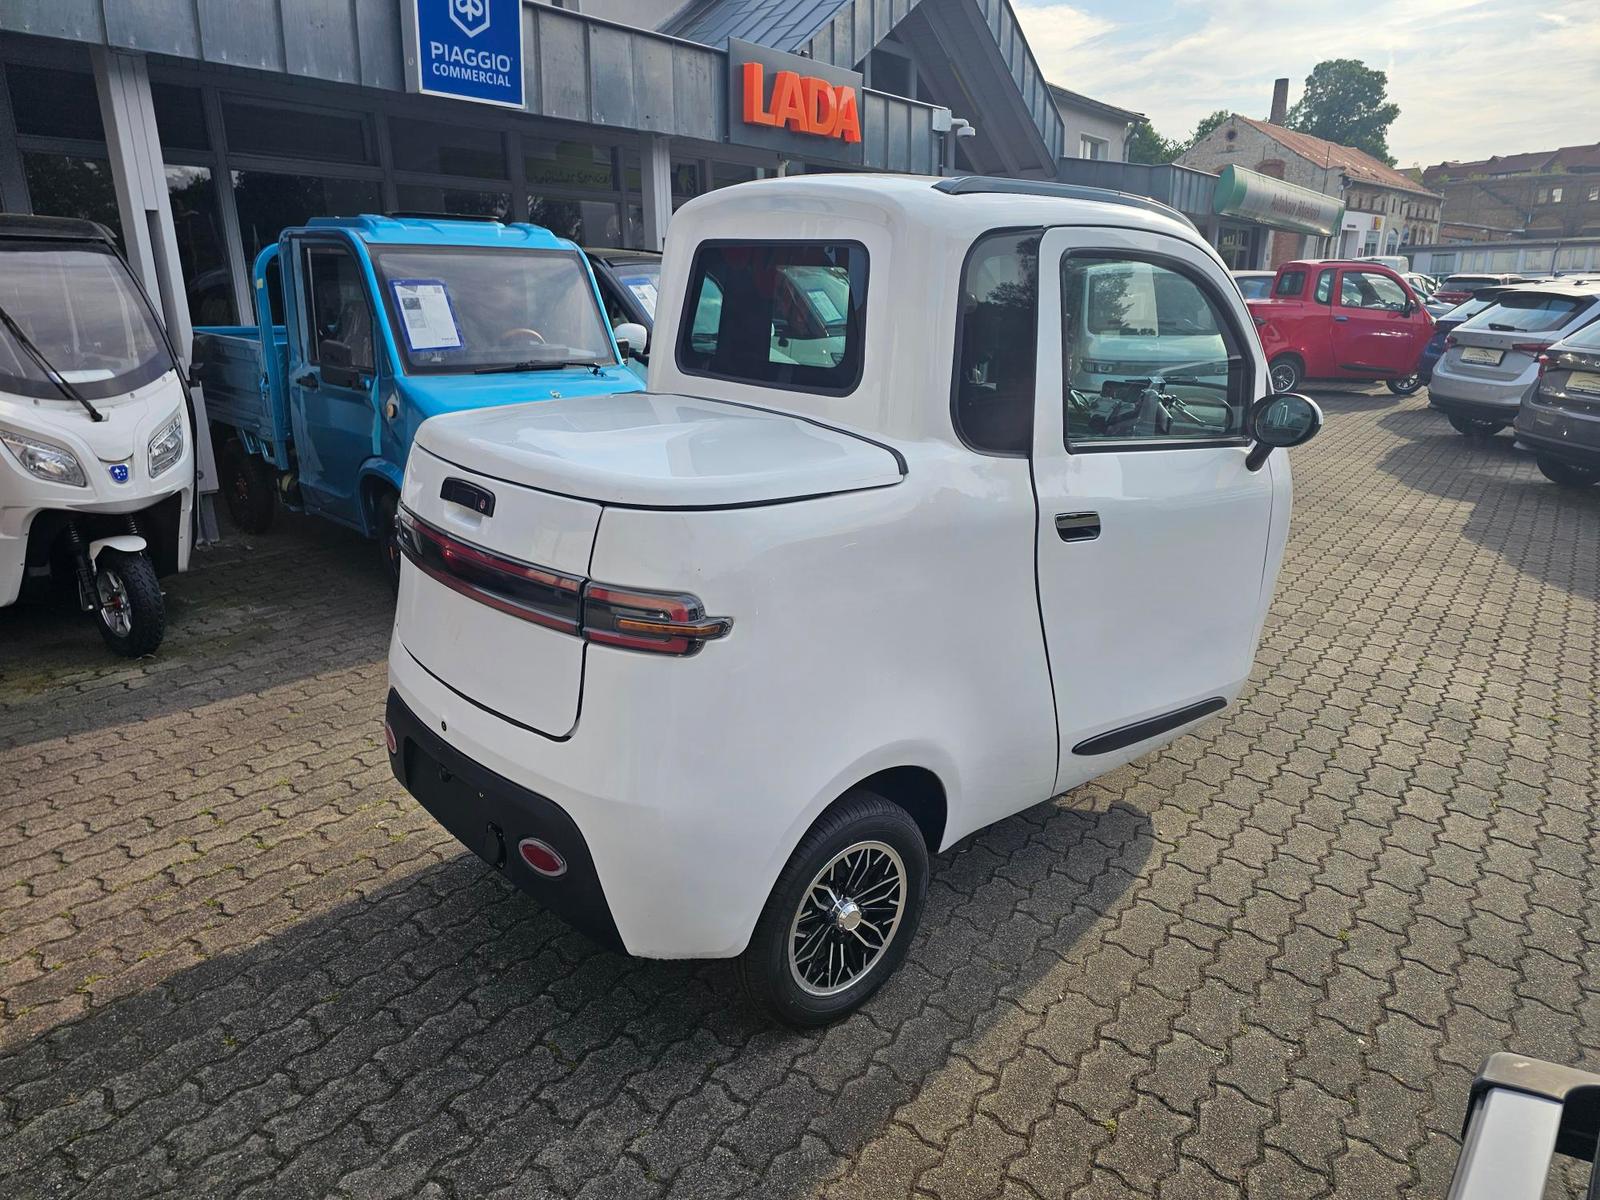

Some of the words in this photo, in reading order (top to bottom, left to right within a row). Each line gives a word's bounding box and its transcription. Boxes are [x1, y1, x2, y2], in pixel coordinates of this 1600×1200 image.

[430, 41, 511, 73] PIAGGIO
[432, 62, 512, 87] COMMERCIAL
[743, 62, 862, 143] LADA
